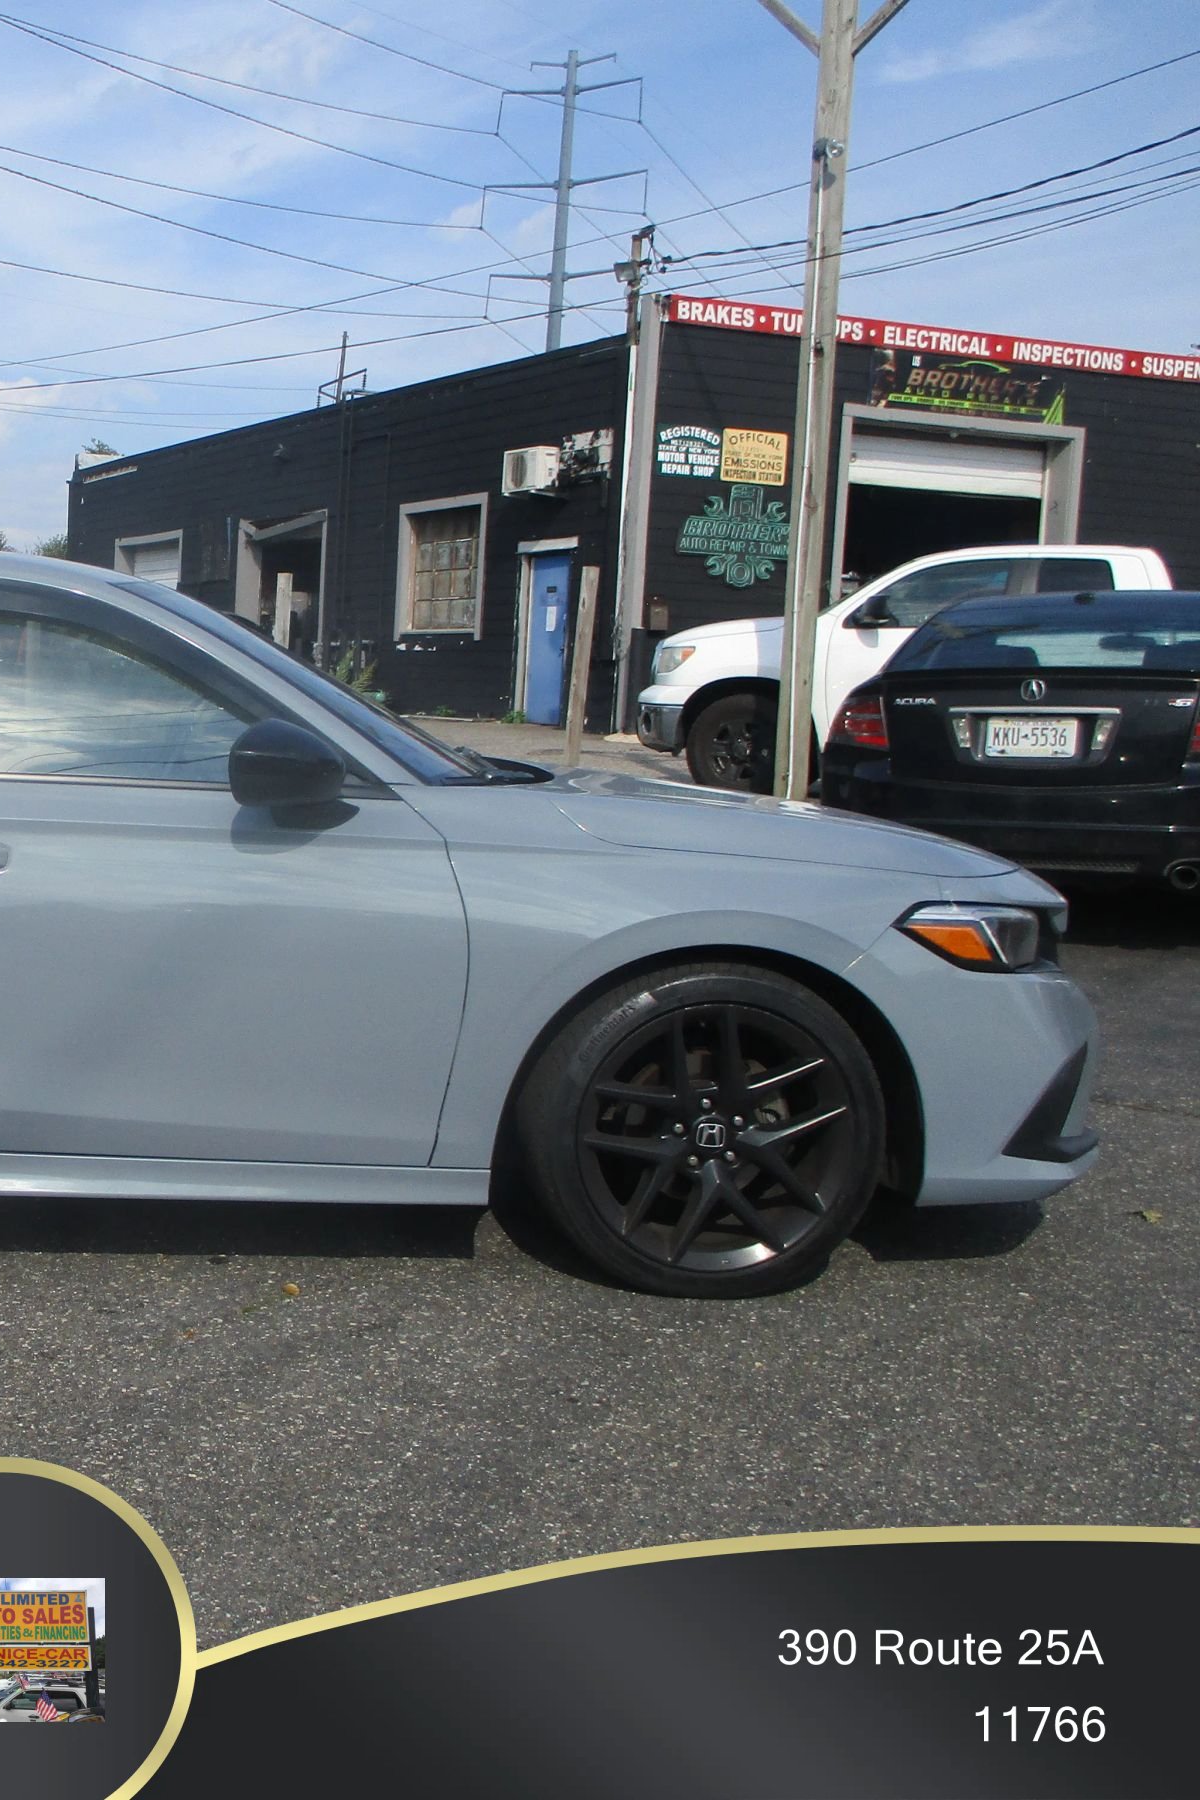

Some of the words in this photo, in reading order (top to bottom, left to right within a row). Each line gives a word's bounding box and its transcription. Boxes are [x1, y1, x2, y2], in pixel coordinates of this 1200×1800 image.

[677, 300, 755, 327] BRAKES
[883, 325, 991, 357] ELECTRICAL
[1012, 341, 1124, 371] INSPECTIONS
[904, 386, 950, 398] AUTO
[966, 393, 1036, 406] REPAIR
[660, 426, 720, 446] REGISTERED
[729, 432, 781, 451] OFFICIAL
[658, 444, 677, 452] STATE
[704, 448, 720, 456] YORK
[657, 451, 686, 464] MOTOR
[687, 453, 720, 467] VEHICLE
[724, 457, 782, 472] EMISSIONS
[661, 463, 690, 476] REPAIR
[692, 465, 715, 478] SHOP
[723, 468, 756, 480] INSPECTION
[757, 471, 782, 482] STATION
[680, 537, 707, 550] AUTO
[709, 539, 745, 553] REPAIR
[748, 542, 757, 553] &
[894, 697, 936, 705] ACURA
